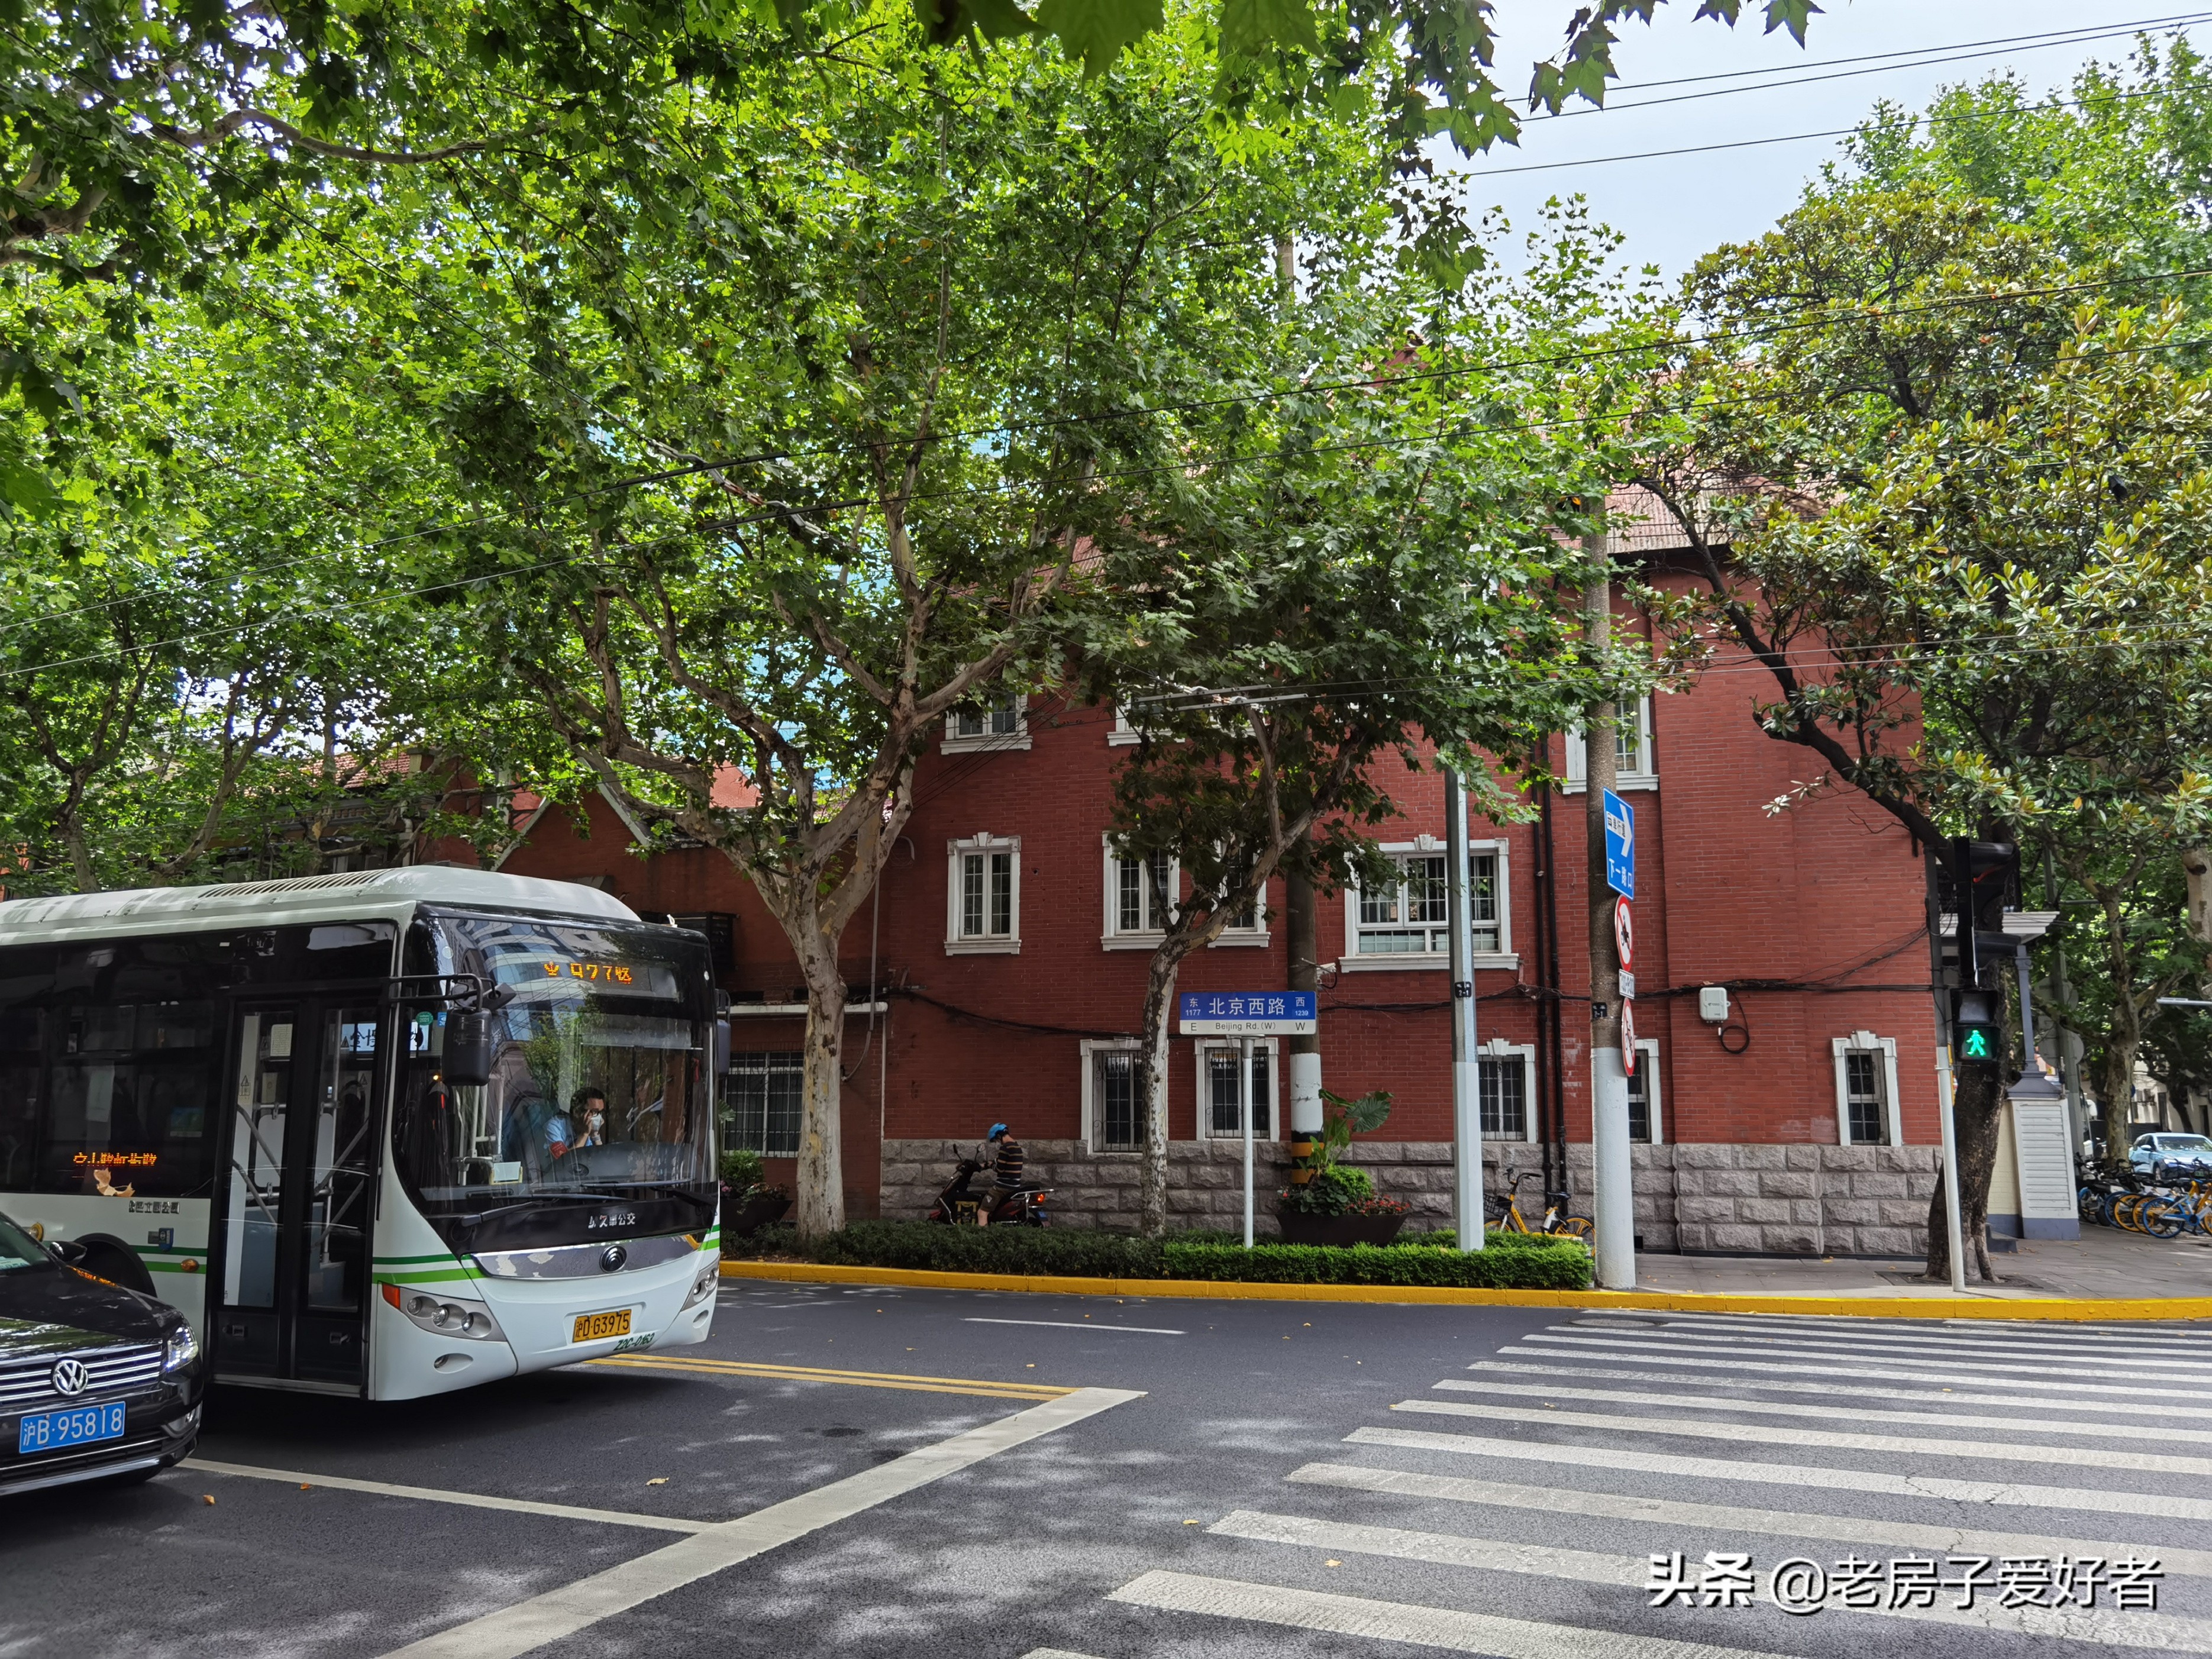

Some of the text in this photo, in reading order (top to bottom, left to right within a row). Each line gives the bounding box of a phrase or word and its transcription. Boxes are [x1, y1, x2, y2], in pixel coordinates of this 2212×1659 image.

[1189, 998, 1199, 1007] 东
[1295, 997, 1305, 1006] 西
[1209, 998, 1285, 1015] 北京西路
[1191, 1023, 1197, 1031] E
[1215, 1022, 1242, 1031] Beijing
[1295, 1022, 1306, 1031] W
[575, 1313, 630, 1338] 沪D·G3975
[22, 1408, 122, 1446] 沪B·95818
